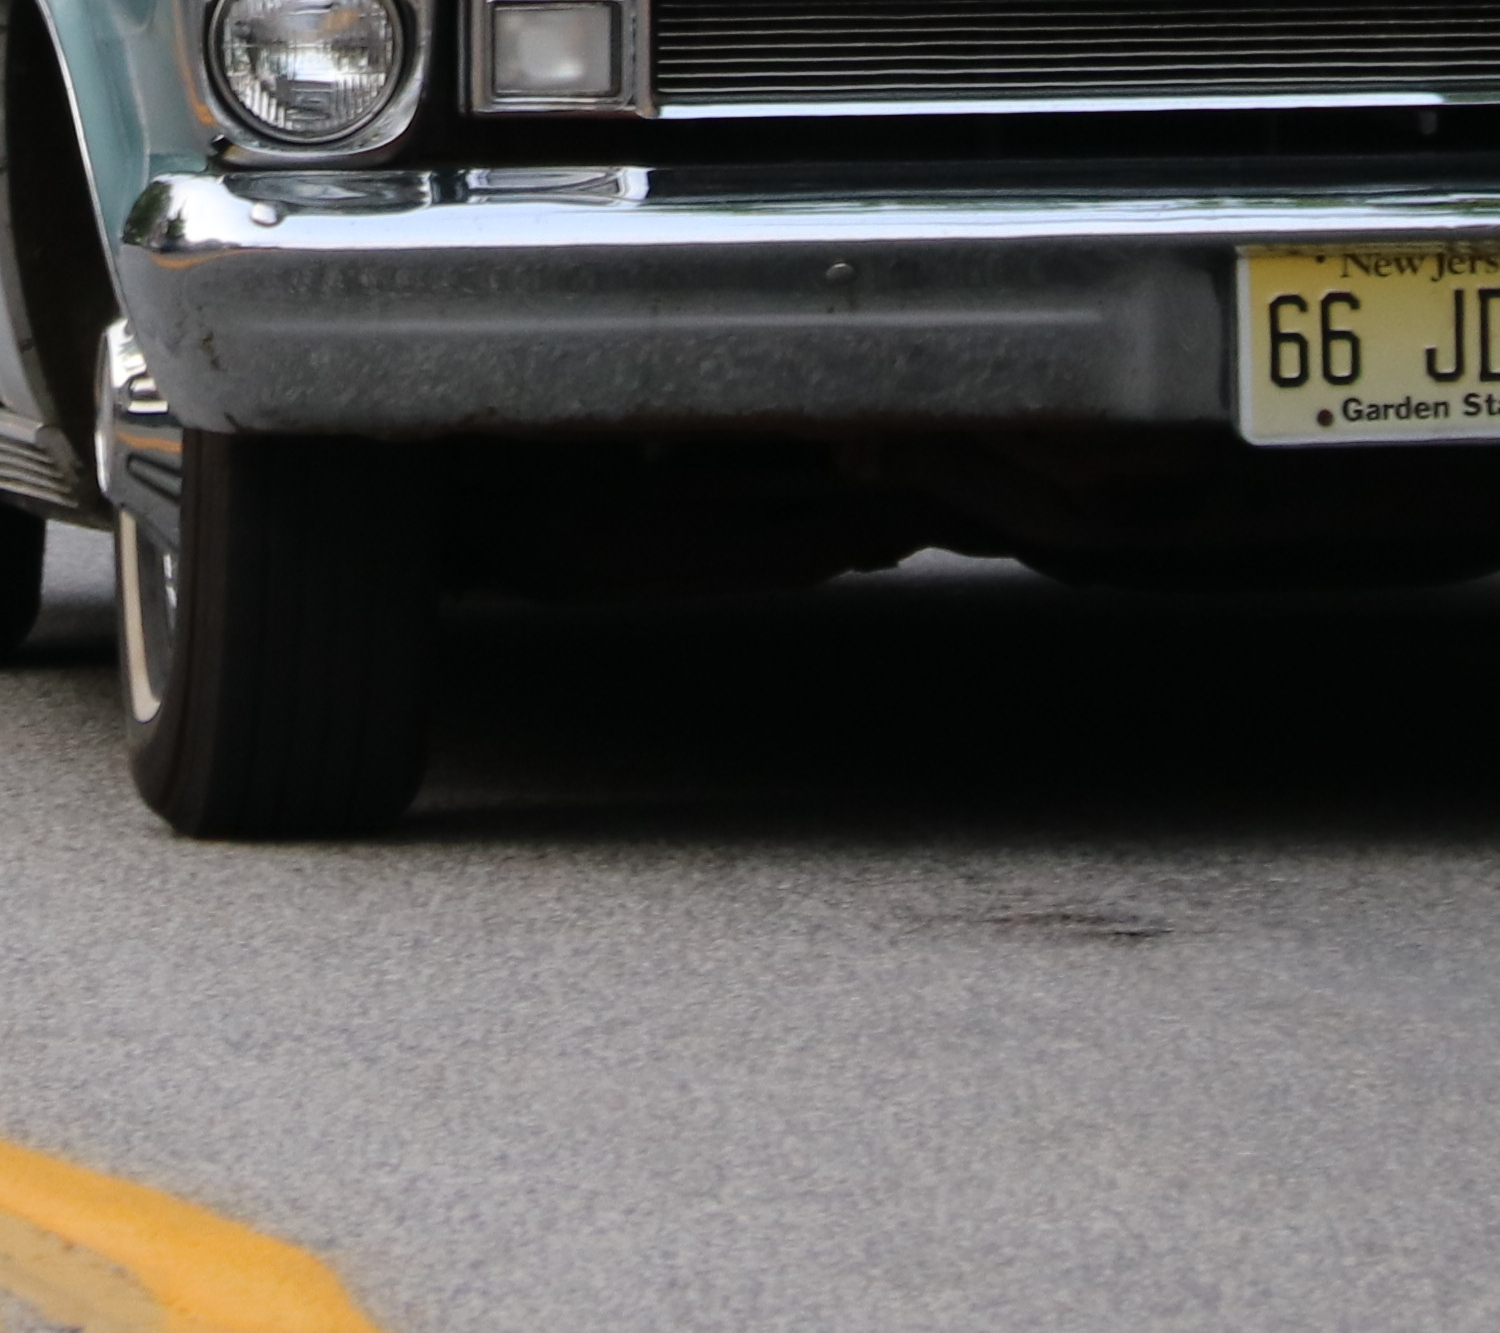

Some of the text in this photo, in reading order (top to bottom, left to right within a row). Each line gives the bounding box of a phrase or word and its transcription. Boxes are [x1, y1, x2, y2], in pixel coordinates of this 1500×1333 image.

[1340, 252, 1424, 280] New
[1268, 292, 1361, 389] 66
[1341, 396, 1450, 423] Garden
